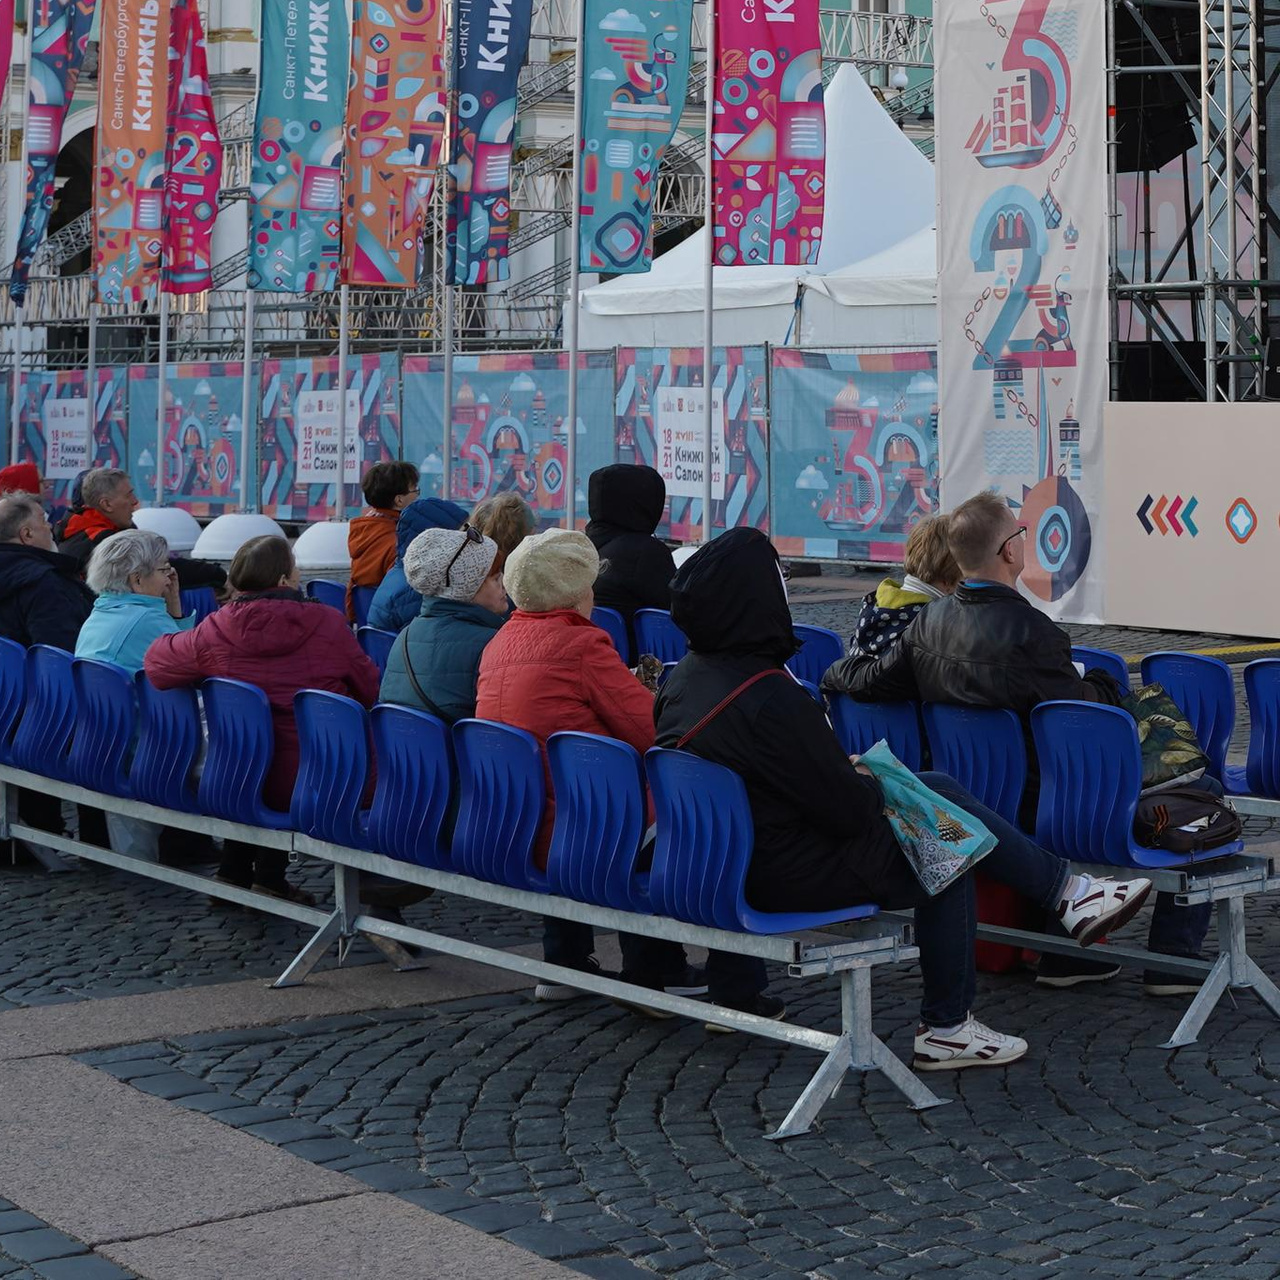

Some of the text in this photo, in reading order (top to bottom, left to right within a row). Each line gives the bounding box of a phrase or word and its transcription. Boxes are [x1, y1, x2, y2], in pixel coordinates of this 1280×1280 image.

[304, 426, 312, 439] 18
[664, 428, 672, 444] 18
[61, 442, 87, 454] Книжны
[304, 446, 312, 460] 21
[664, 452, 672, 468] 21
[675, 464, 704, 482] Салон
